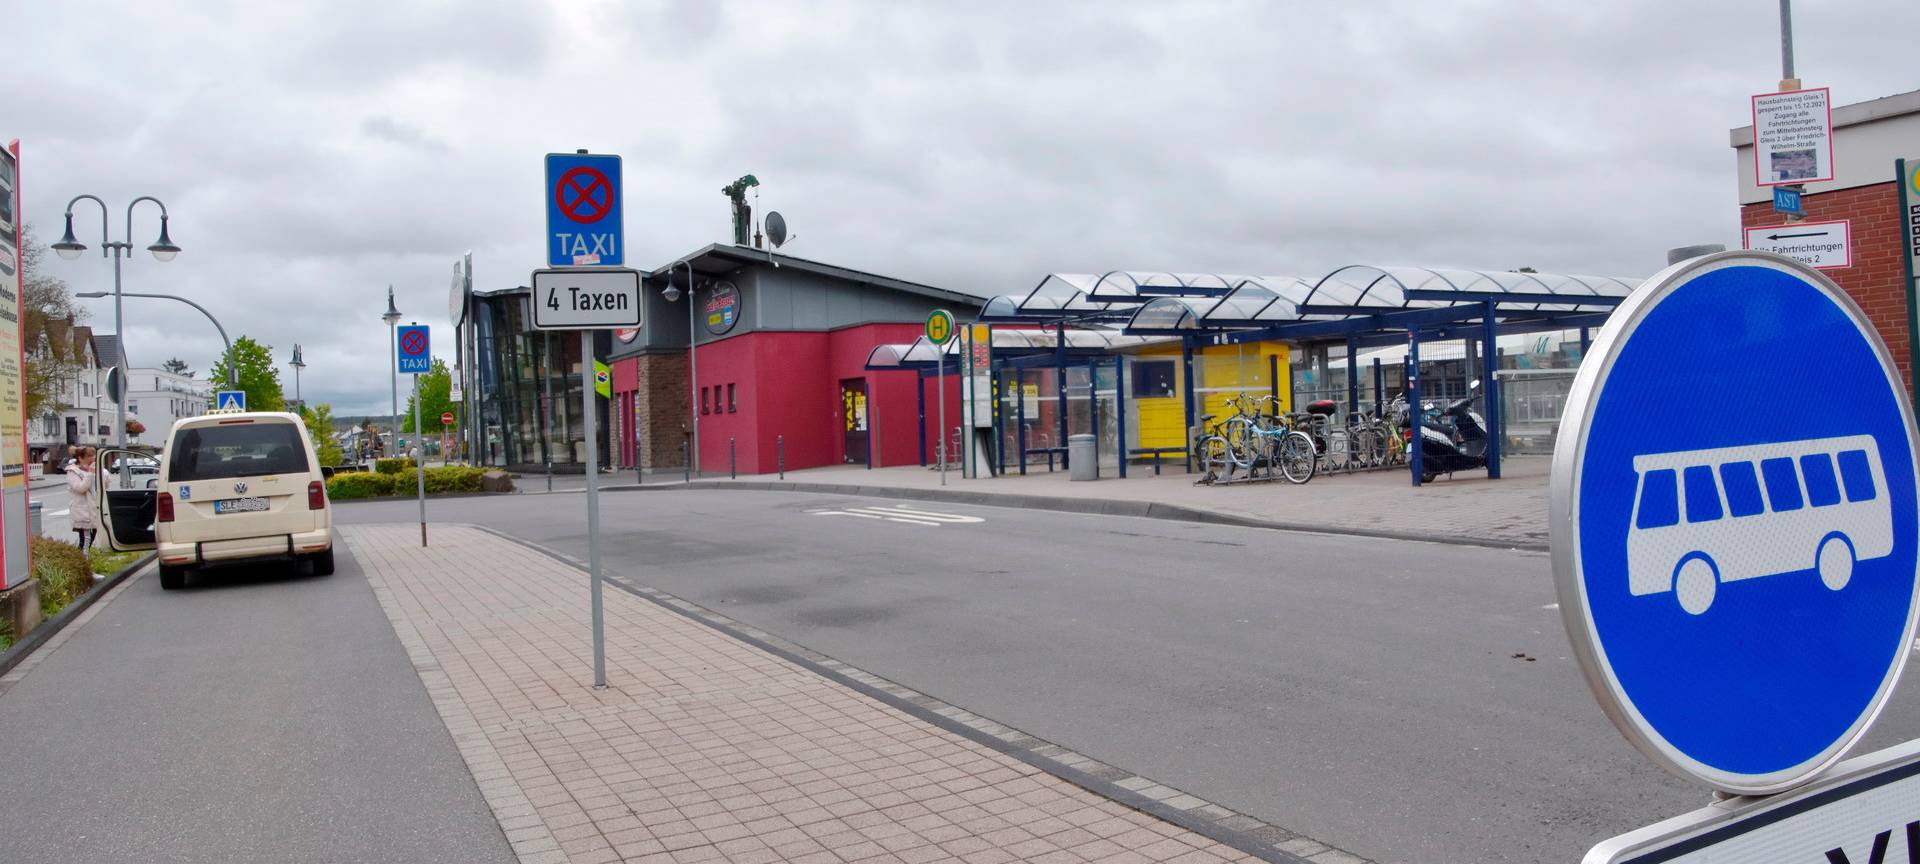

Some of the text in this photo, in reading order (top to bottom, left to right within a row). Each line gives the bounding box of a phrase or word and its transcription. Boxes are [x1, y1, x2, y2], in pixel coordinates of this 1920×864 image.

[1758, 96, 1802, 105] Hausbahnsteig
[1758, 105, 1782, 114] gesperrt
[1795, 101, 1825, 110] 15.12.2021
[1774, 112, 1797, 120] Zugang
[1768, 118, 1816, 127] Fahrtrichtungen
[1777, 125, 1823, 134] Mittelbahnsteig
[1796, 132, 1826, 140] Friedrich-
[1771, 141, 1816, 150] Wilhelm-Straße
[1777, 193, 1796, 209] AST
[555, 233, 615, 256] TAXI
[1772, 243, 1843, 254] Fahrtrichtungen
[1814, 254, 1820, 263] 2
[547, 287, 628, 311] 4 Taxen
[933, 317, 943, 338] H
[401, 358, 427, 369] TAXI
